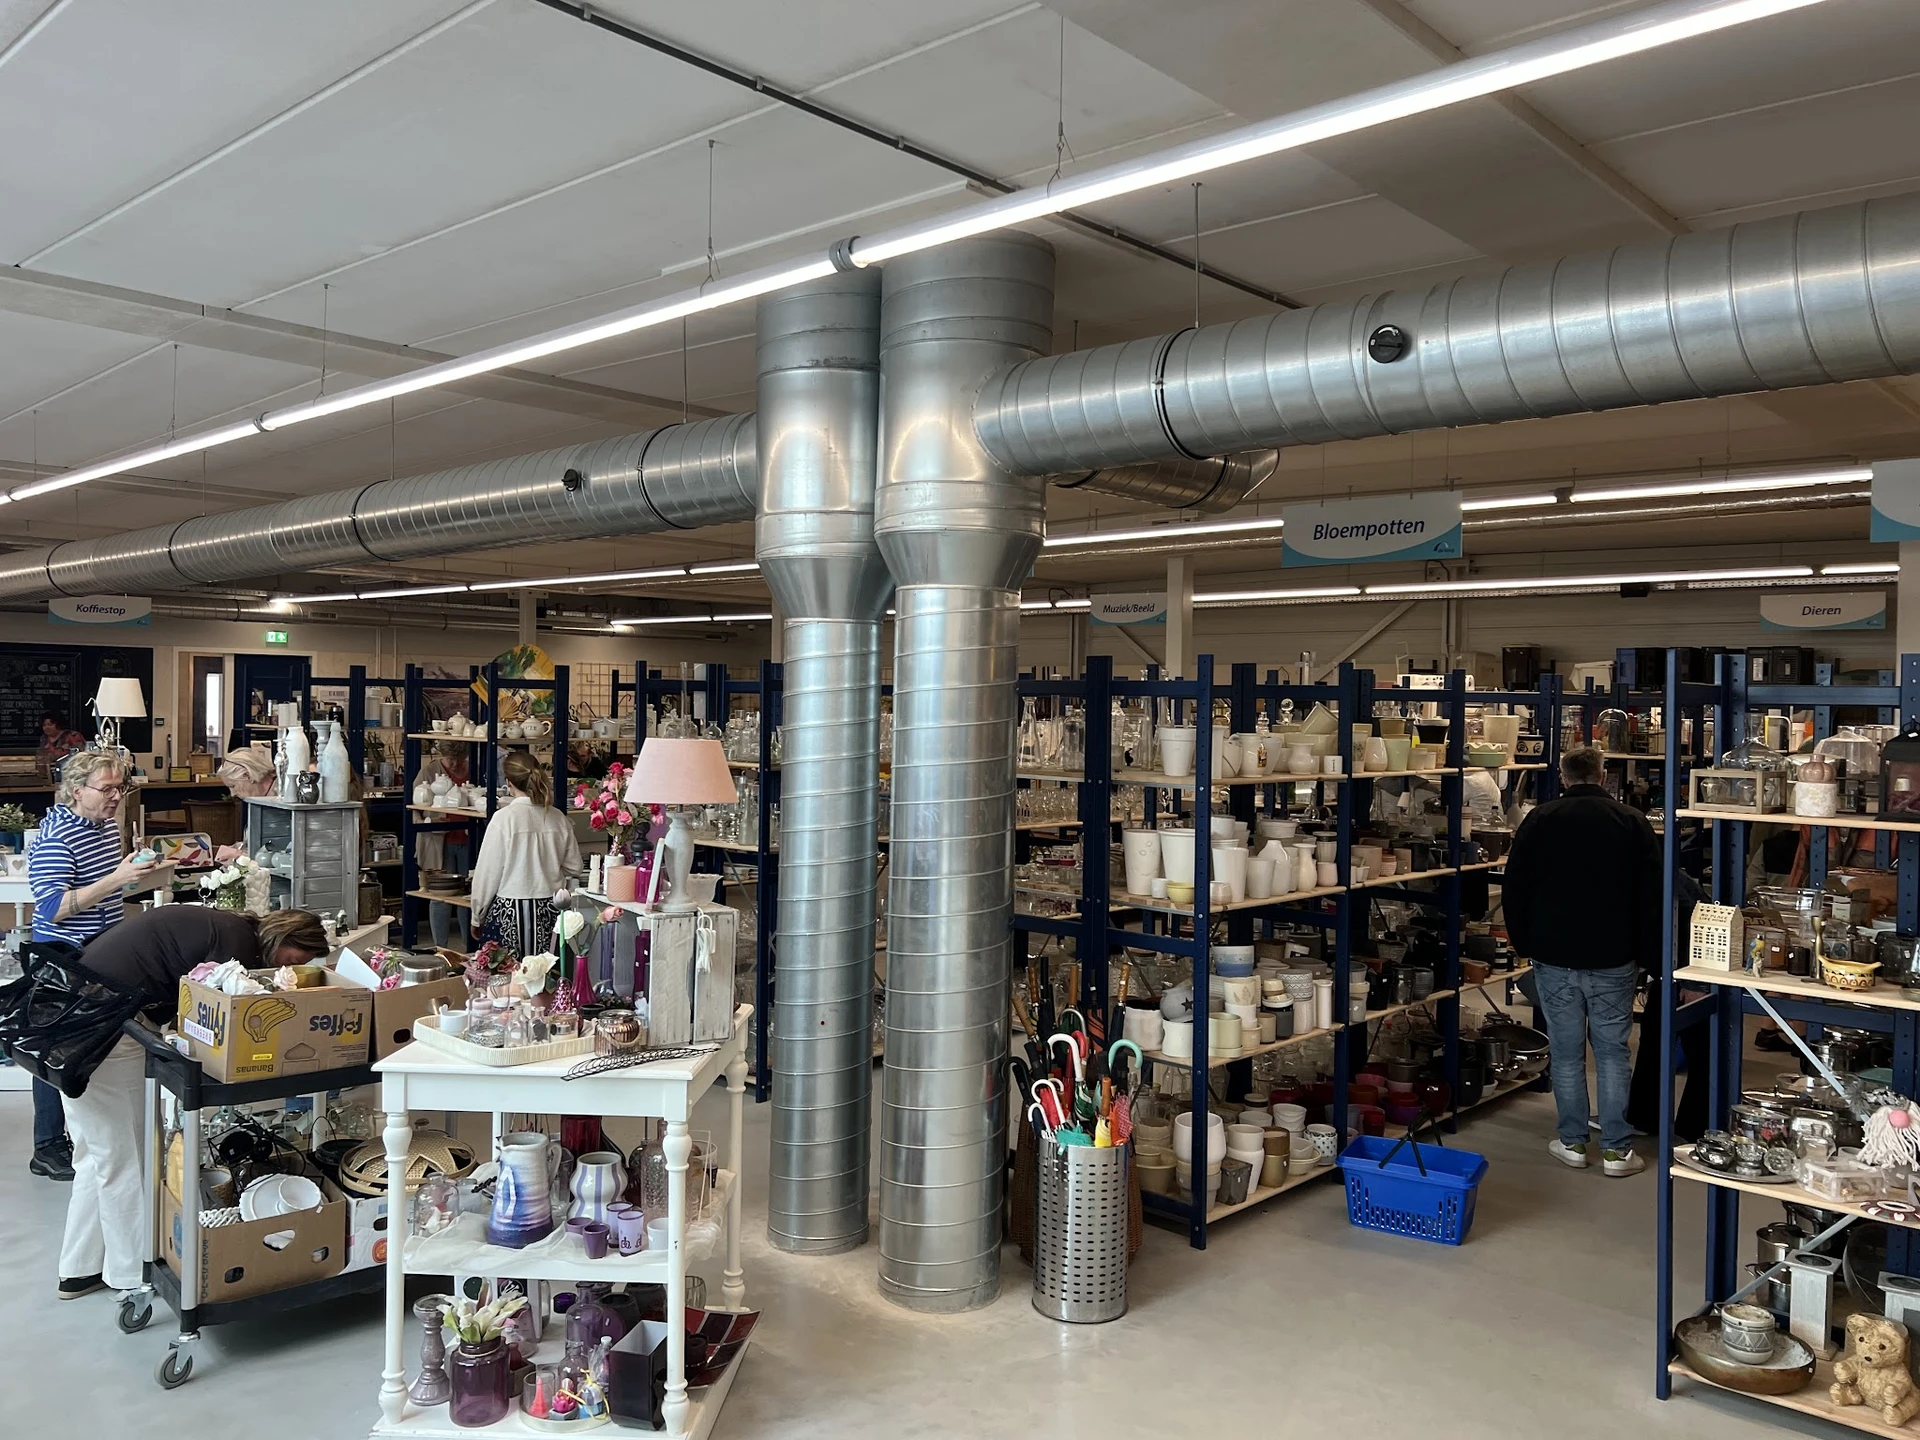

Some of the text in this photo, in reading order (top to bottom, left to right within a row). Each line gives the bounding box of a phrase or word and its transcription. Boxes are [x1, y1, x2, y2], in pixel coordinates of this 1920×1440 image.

[1313, 519, 1425, 541] Bloempotten
[75, 603, 126, 618] Koffiestop
[1102, 603, 1155, 613] Muziek/Beeld
[1801, 606, 1842, 616] Dieren
[235, 1064, 274, 1074] Bananas
